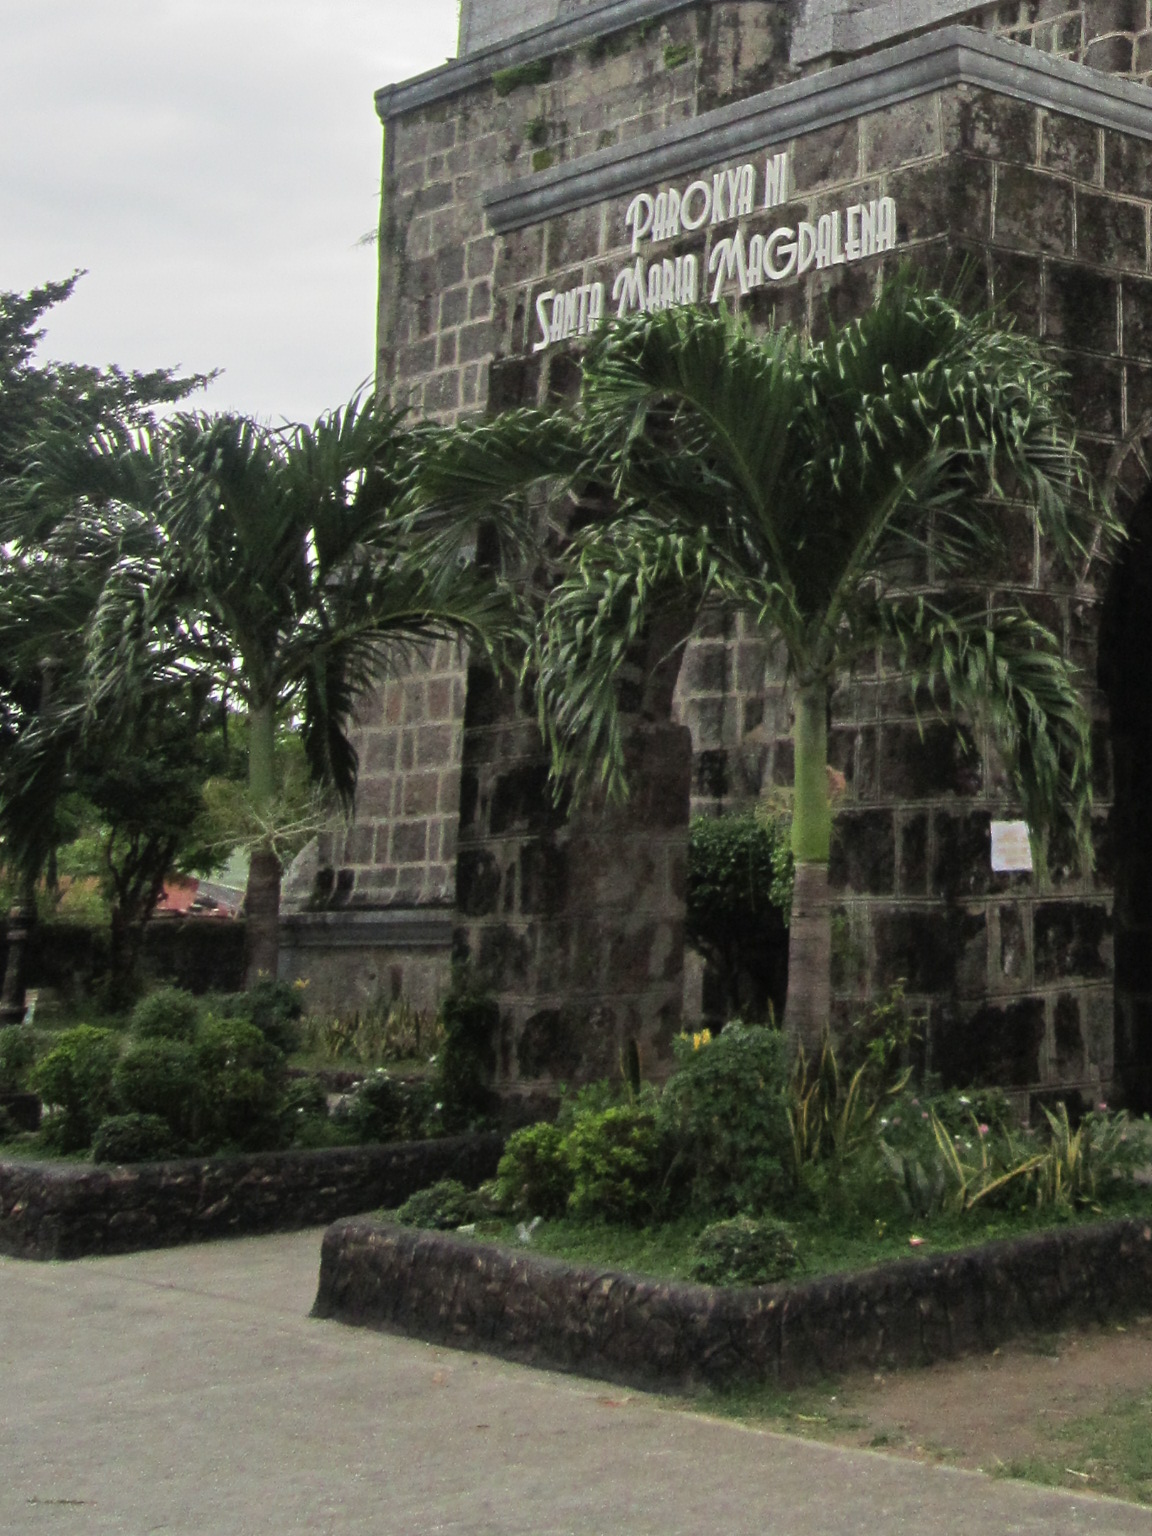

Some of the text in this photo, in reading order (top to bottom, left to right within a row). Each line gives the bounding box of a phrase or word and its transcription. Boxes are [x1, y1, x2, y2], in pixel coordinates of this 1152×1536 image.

[625, 152, 789, 255] PAROKYA NI
[532, 195, 897, 353] SANTA MARIA MAGDALENA
